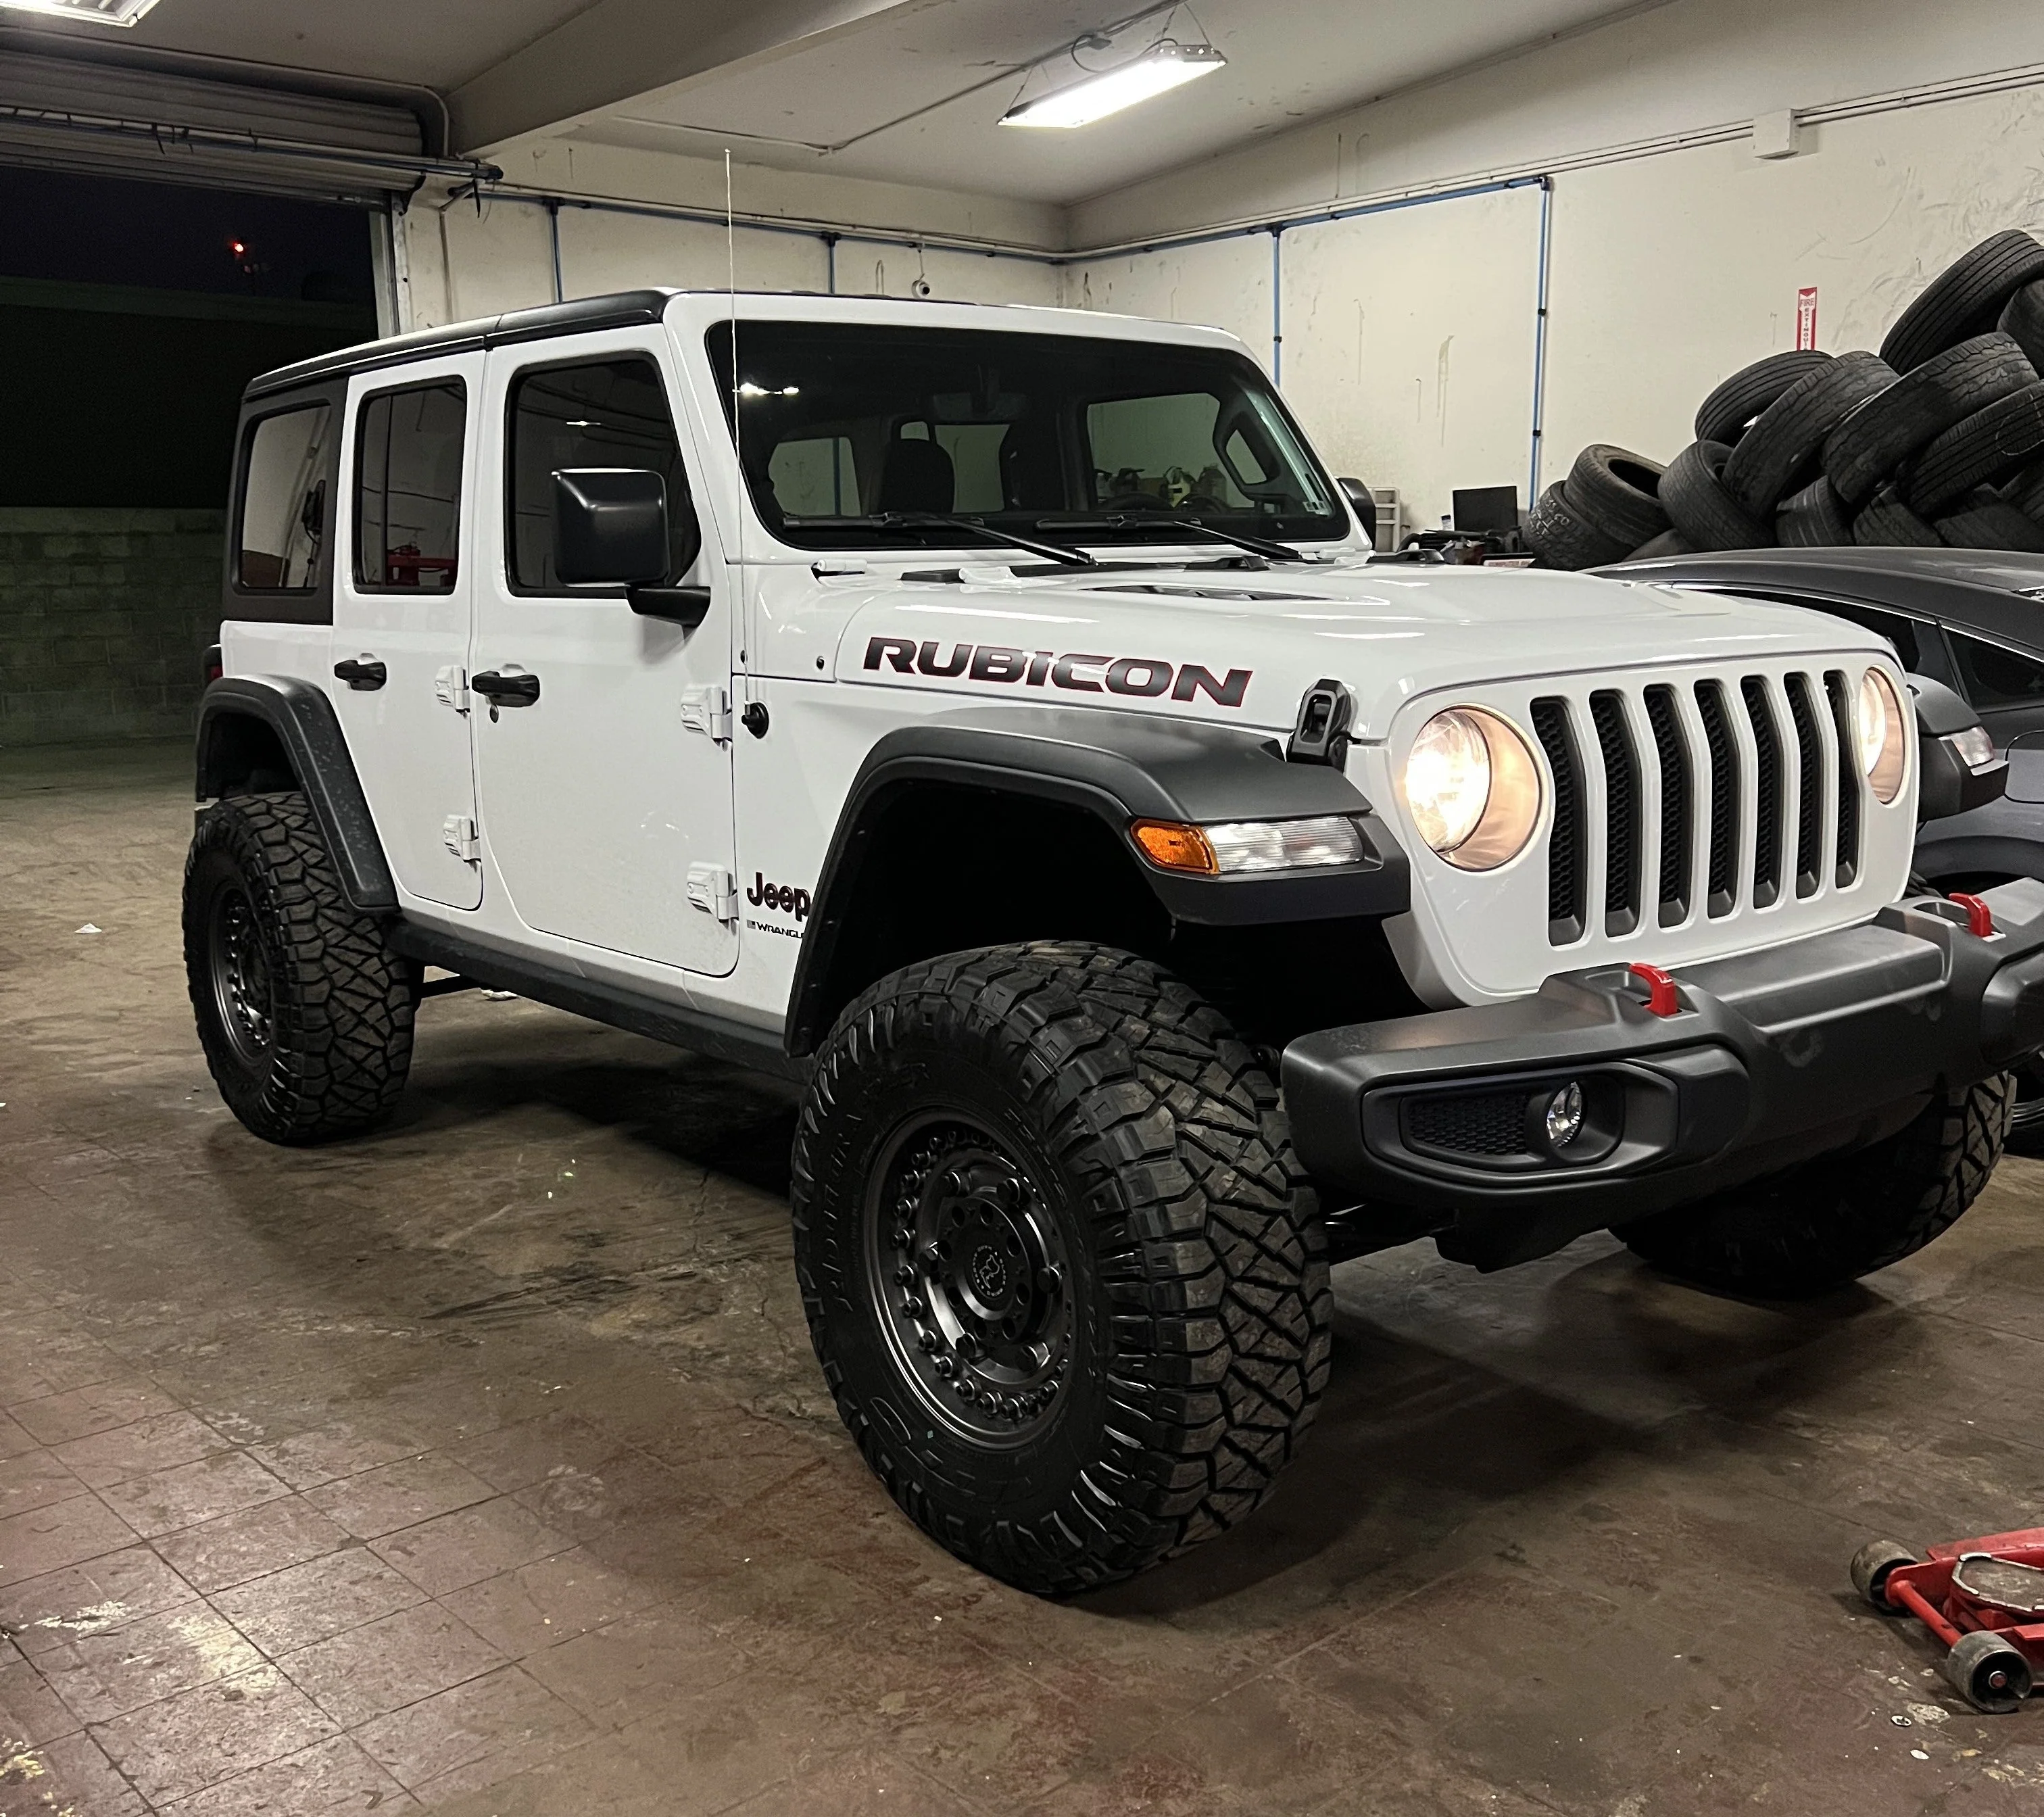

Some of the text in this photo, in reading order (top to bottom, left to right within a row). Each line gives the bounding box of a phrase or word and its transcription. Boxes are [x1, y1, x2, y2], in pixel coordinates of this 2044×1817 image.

[1799, 298, 1815, 306] FIRE
[862, 637, 1254, 708] RUBICON
[747, 872, 810, 922] Jeep
